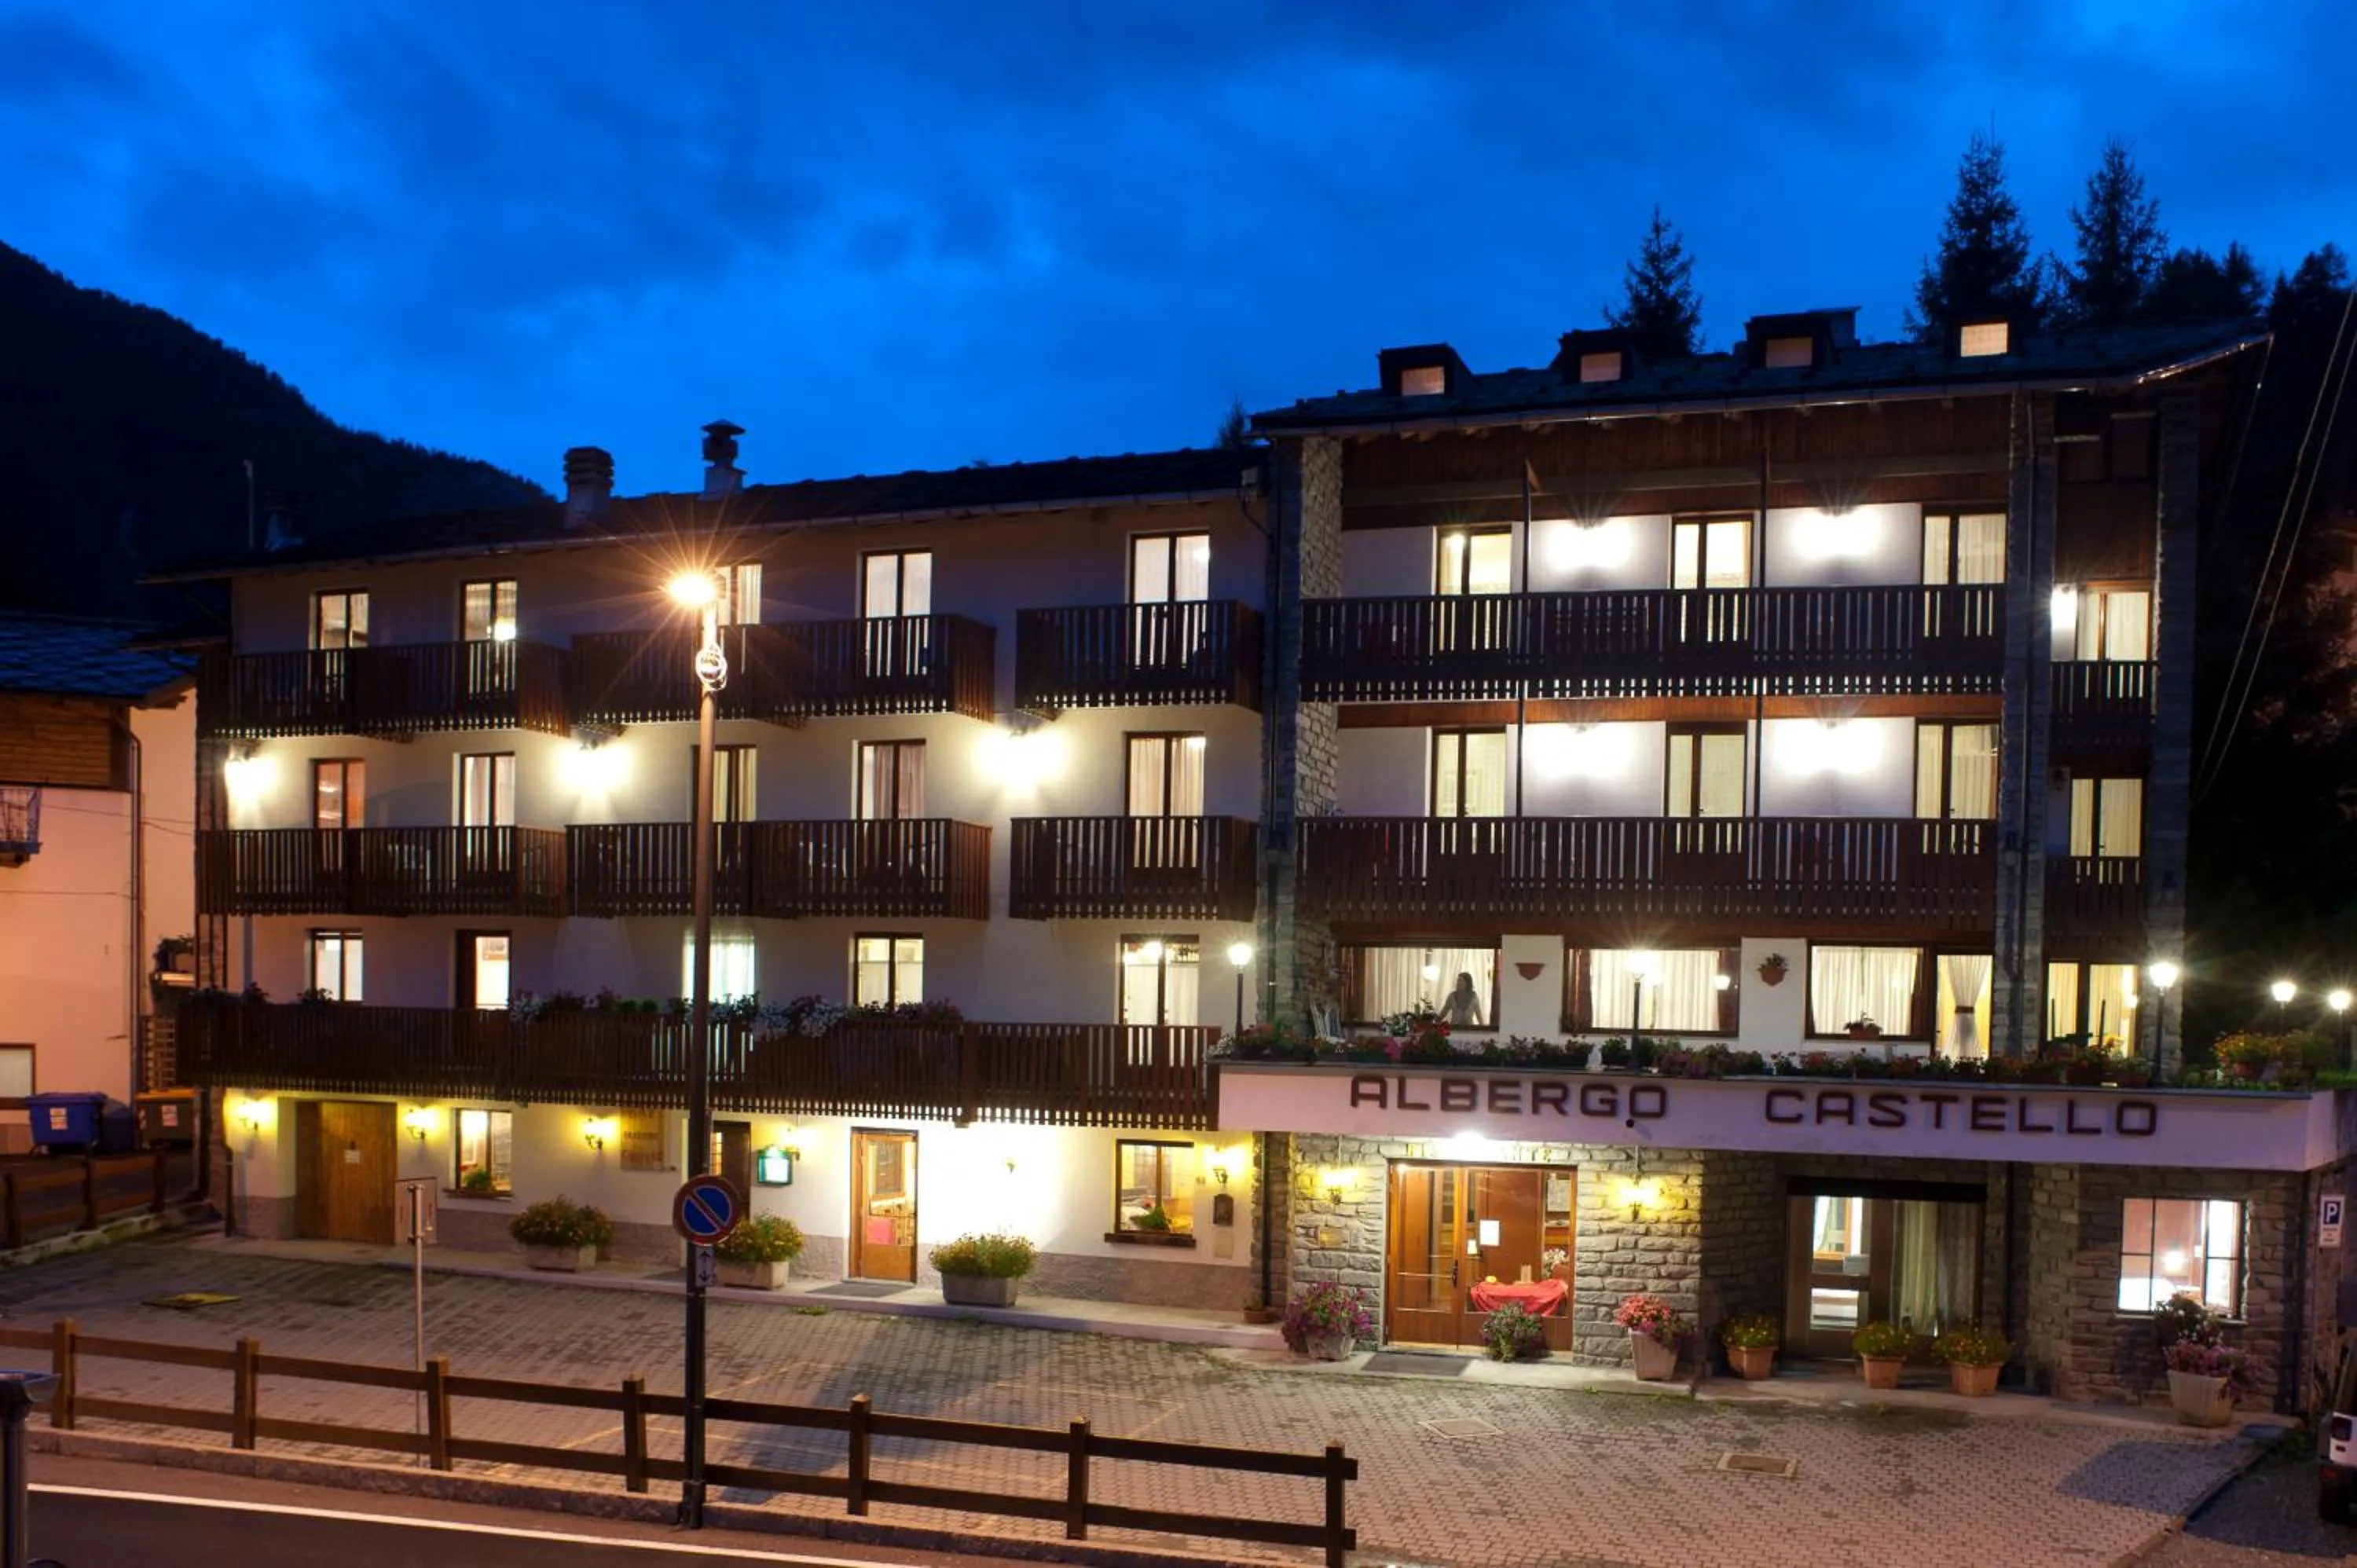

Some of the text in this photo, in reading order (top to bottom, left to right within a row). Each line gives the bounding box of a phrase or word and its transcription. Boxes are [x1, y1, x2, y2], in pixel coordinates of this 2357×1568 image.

[1350, 1073, 2158, 1137] ALBERGO CASTELLO
[2326, 1202, 2338, 1223] P
